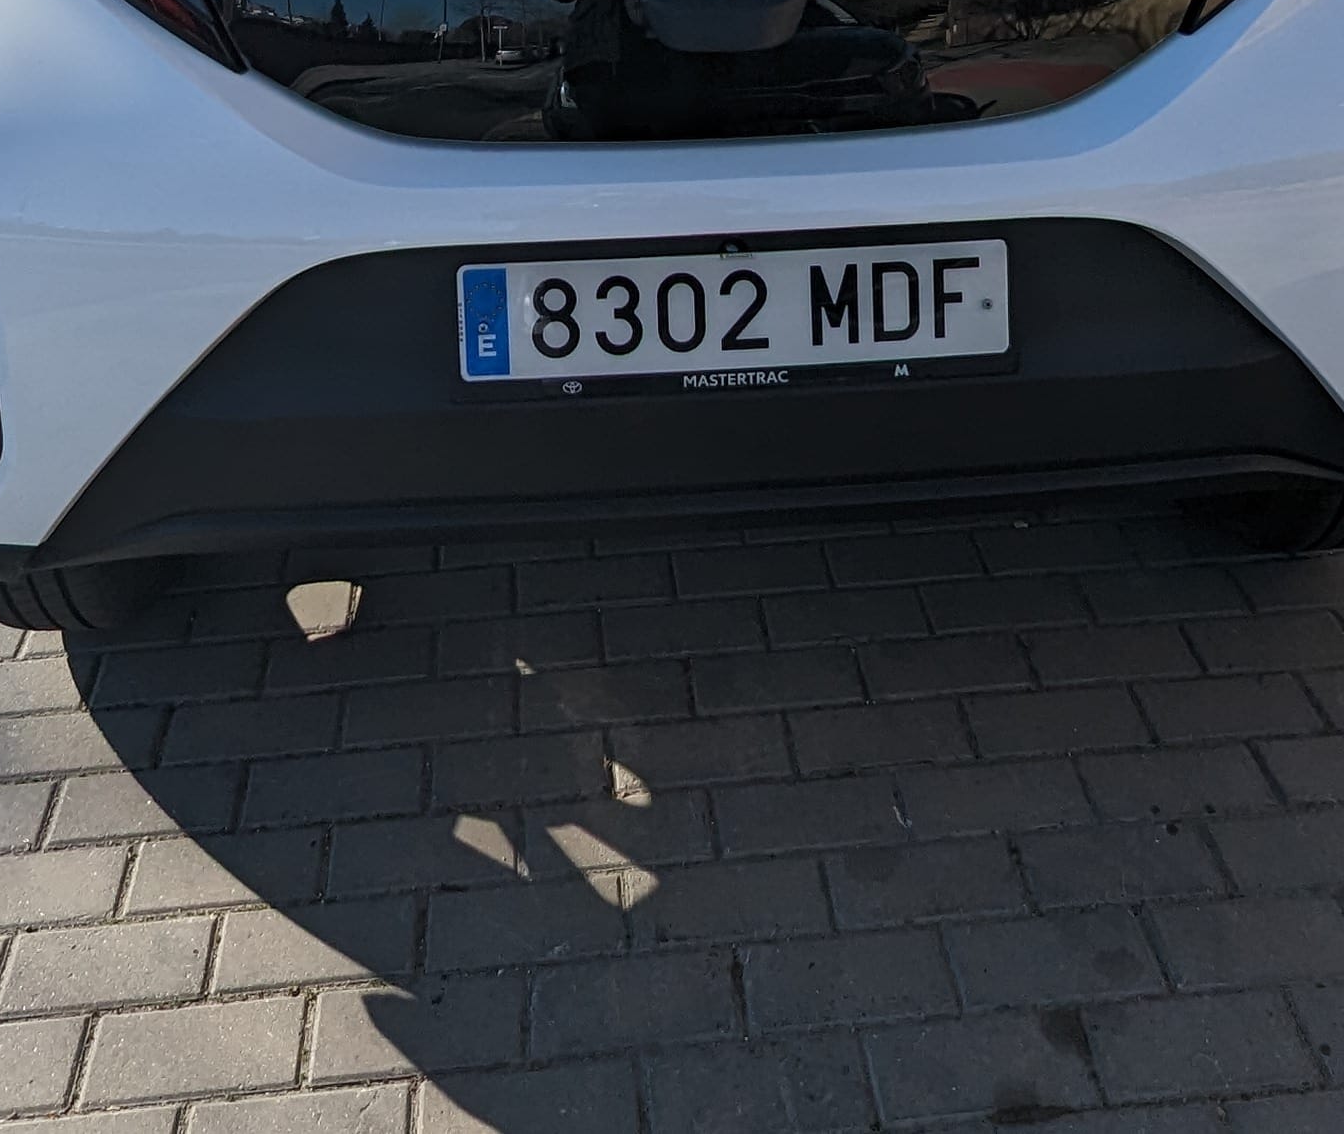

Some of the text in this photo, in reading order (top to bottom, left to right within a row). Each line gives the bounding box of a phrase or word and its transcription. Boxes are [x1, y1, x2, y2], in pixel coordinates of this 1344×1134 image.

[532, 268, 770, 359] 8302
[809, 256, 981, 347] MDF
[477, 333, 498, 358] E
[682, 363, 910, 389] MASTERTRAC M
